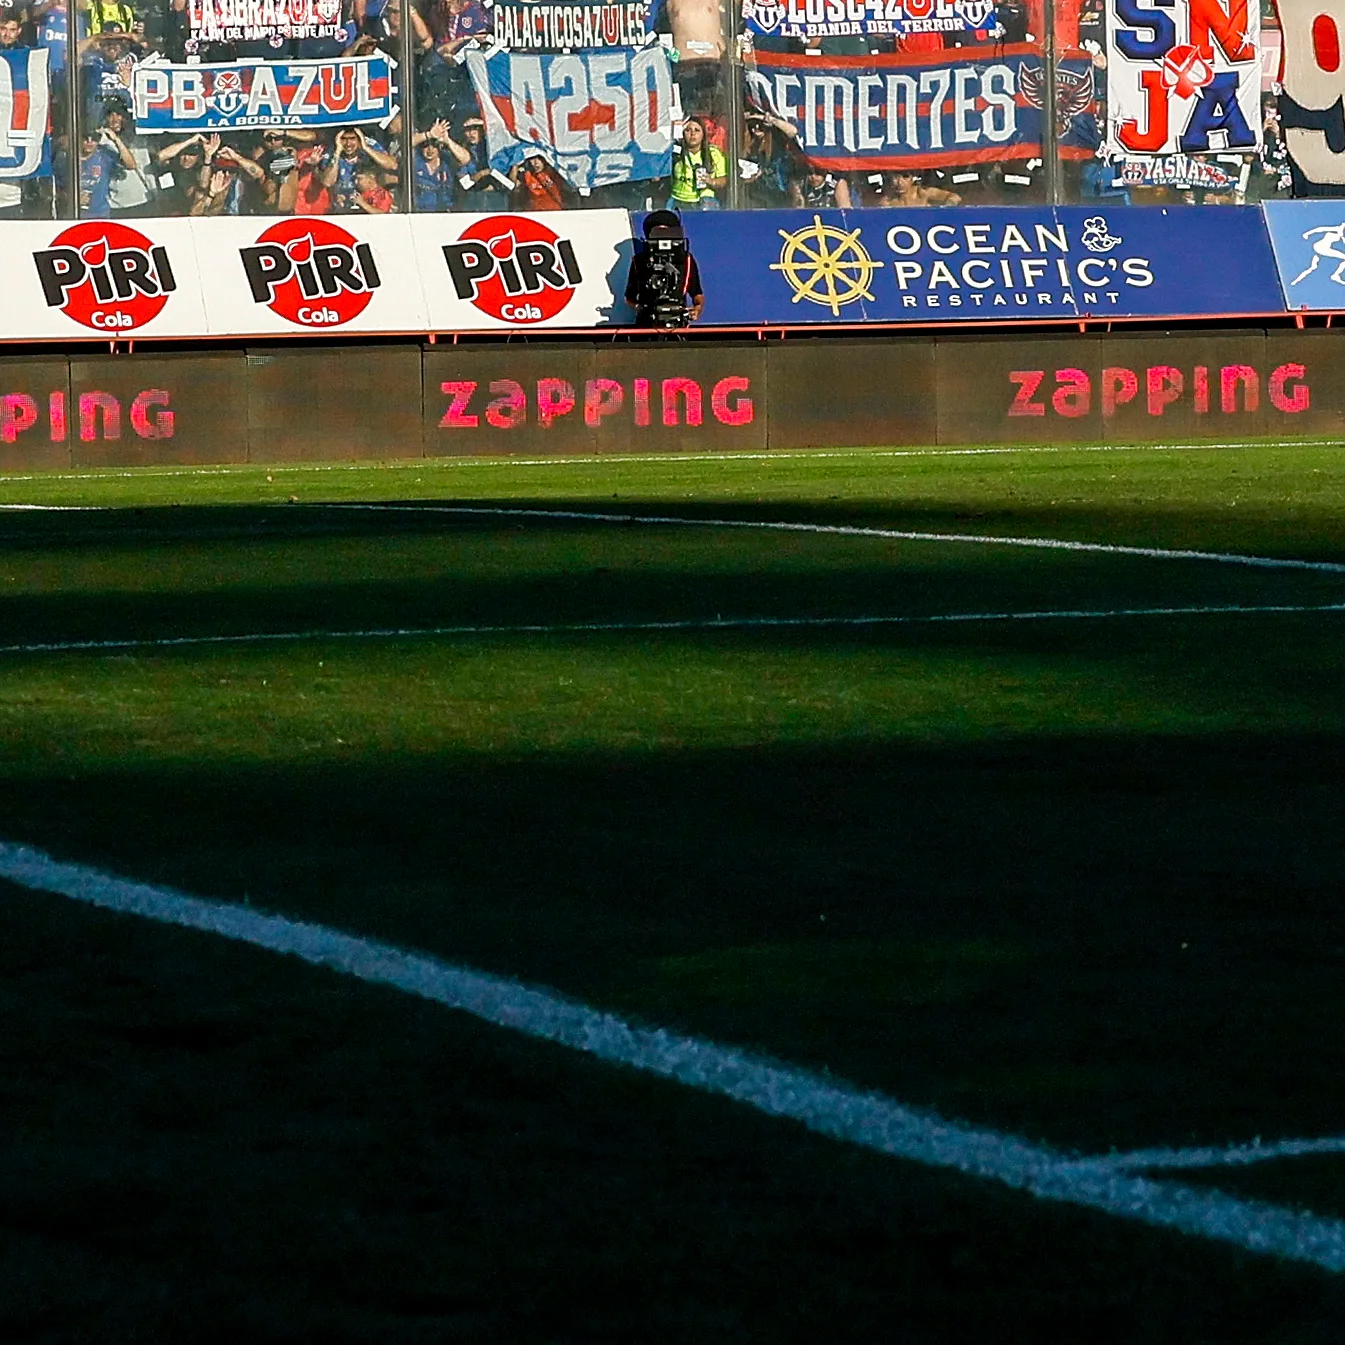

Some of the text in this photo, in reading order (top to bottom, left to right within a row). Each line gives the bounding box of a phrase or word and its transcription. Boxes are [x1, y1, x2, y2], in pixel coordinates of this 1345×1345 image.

[781, 18, 966, 37] LA BANDA DEL TERROR
[208, 115, 230, 127] LA
[886, 224, 1069, 255] OCEAN
[893, 257, 1154, 292] PACIFIC'S
[903, 292, 1120, 309] RESTAURANT
[90, 311, 134, 329] Cola
[297, 306, 340, 325] Cola
[500, 303, 542, 322] Cola
